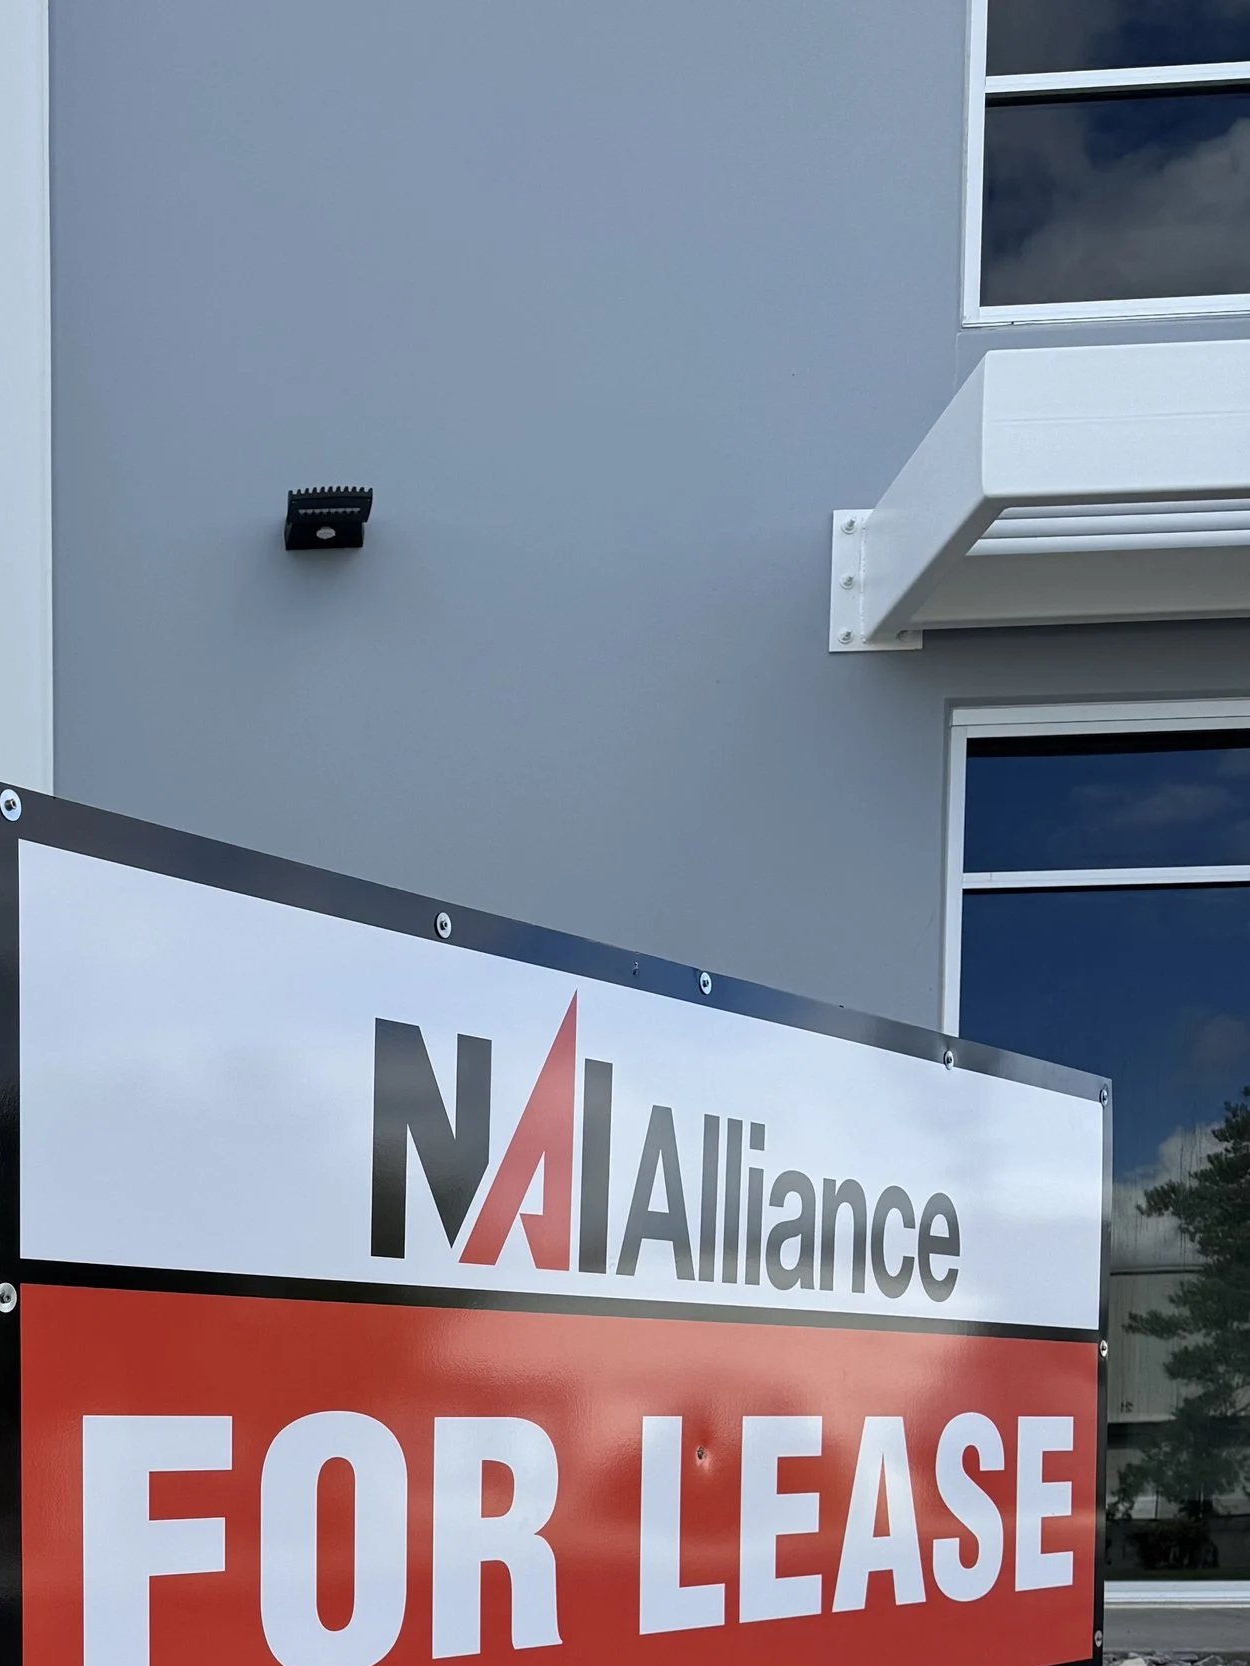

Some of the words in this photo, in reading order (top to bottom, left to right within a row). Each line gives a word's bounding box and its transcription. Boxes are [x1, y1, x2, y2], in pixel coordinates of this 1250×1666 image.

[371, 990, 612, 1274] NAI
[616, 1106, 960, 1302] Alliance
[639, 1412, 1075, 1635] LEASE
